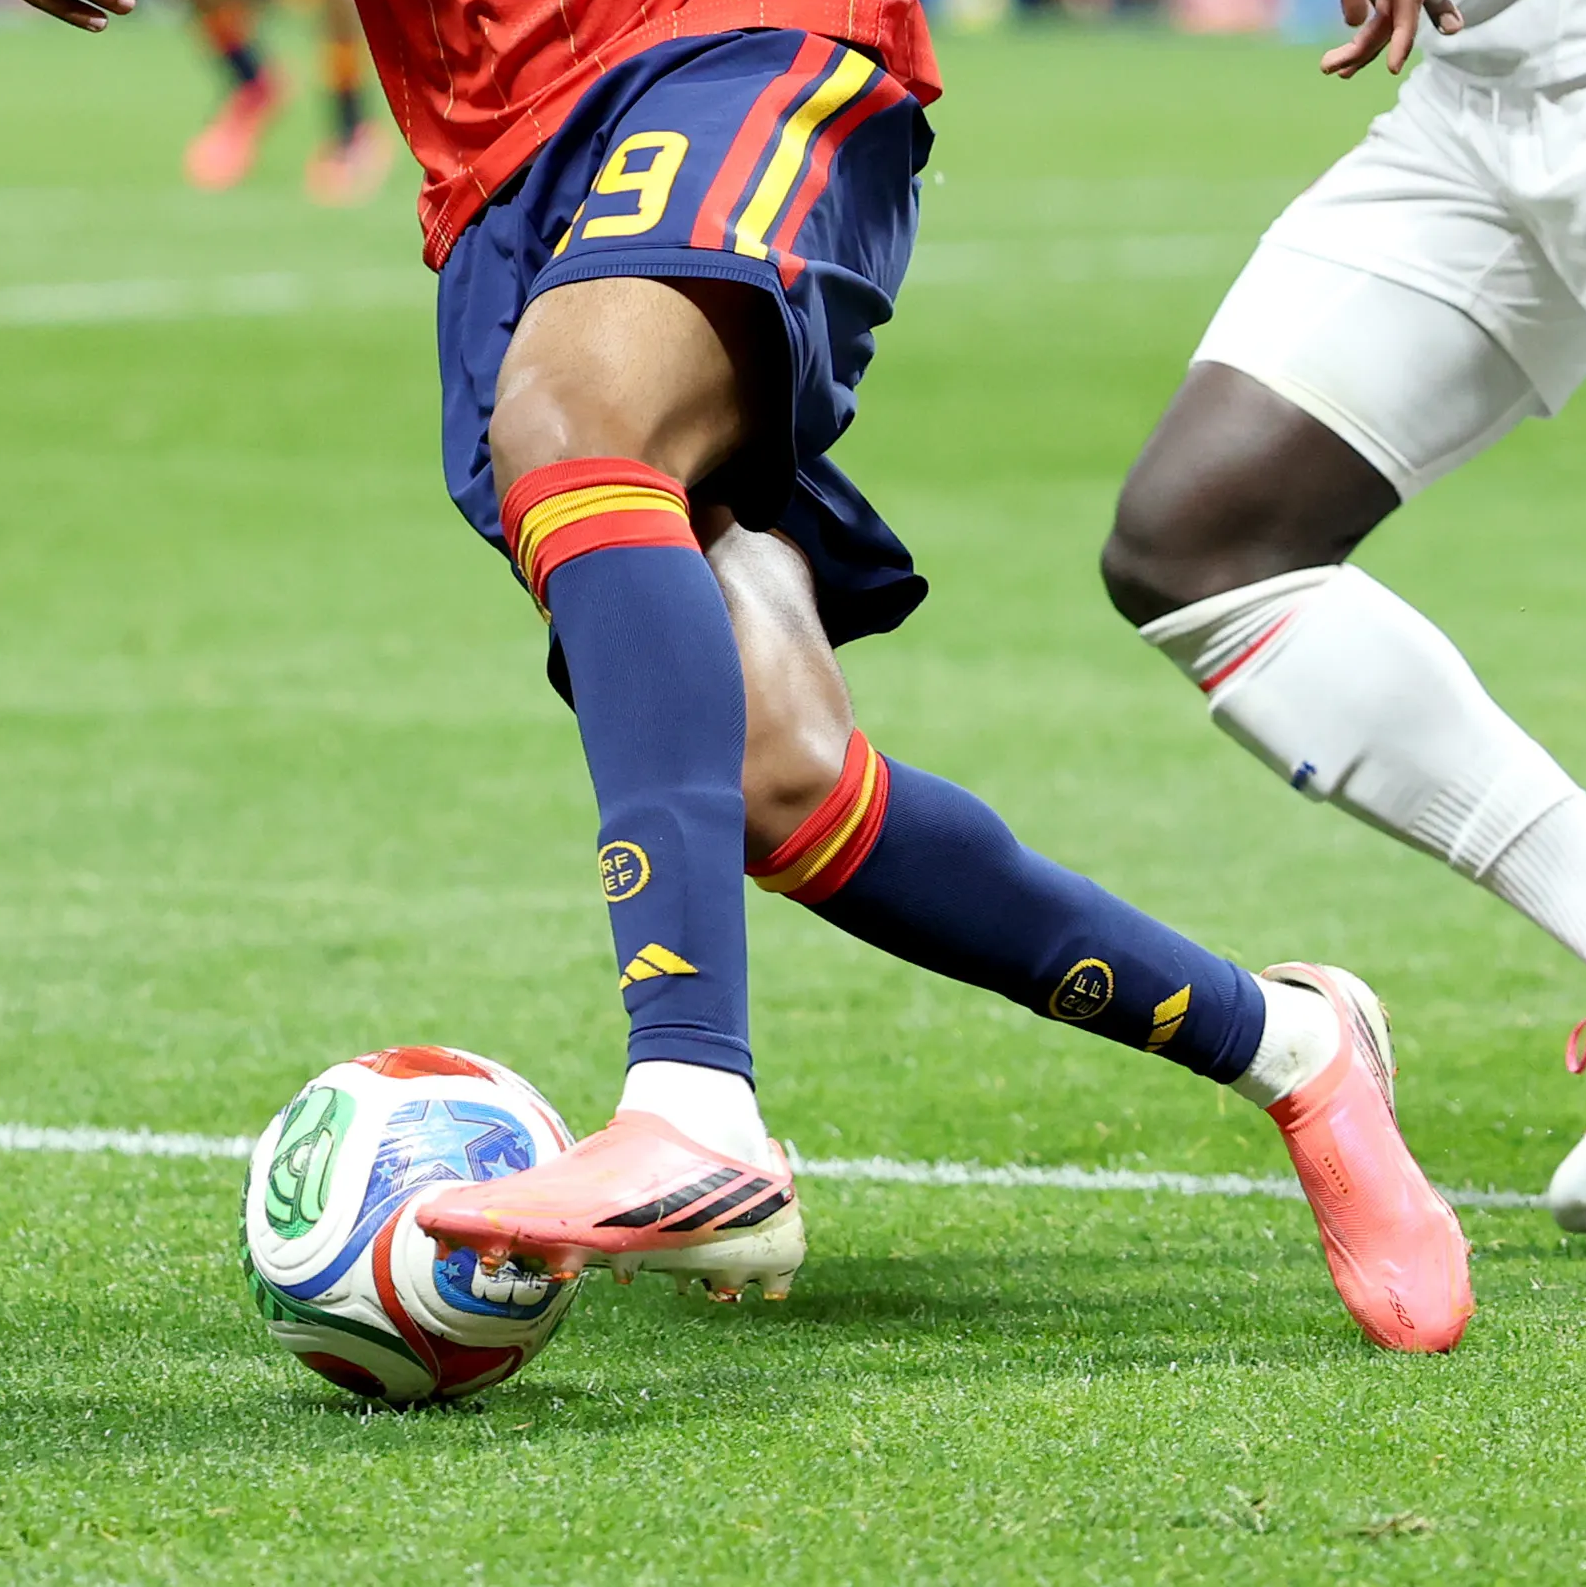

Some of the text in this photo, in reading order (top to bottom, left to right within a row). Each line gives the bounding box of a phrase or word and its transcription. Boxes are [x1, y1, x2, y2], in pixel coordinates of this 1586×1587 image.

[553, 130, 689, 259] 9
[602, 852, 629, 876] RF
[605, 869, 633, 892] EF
